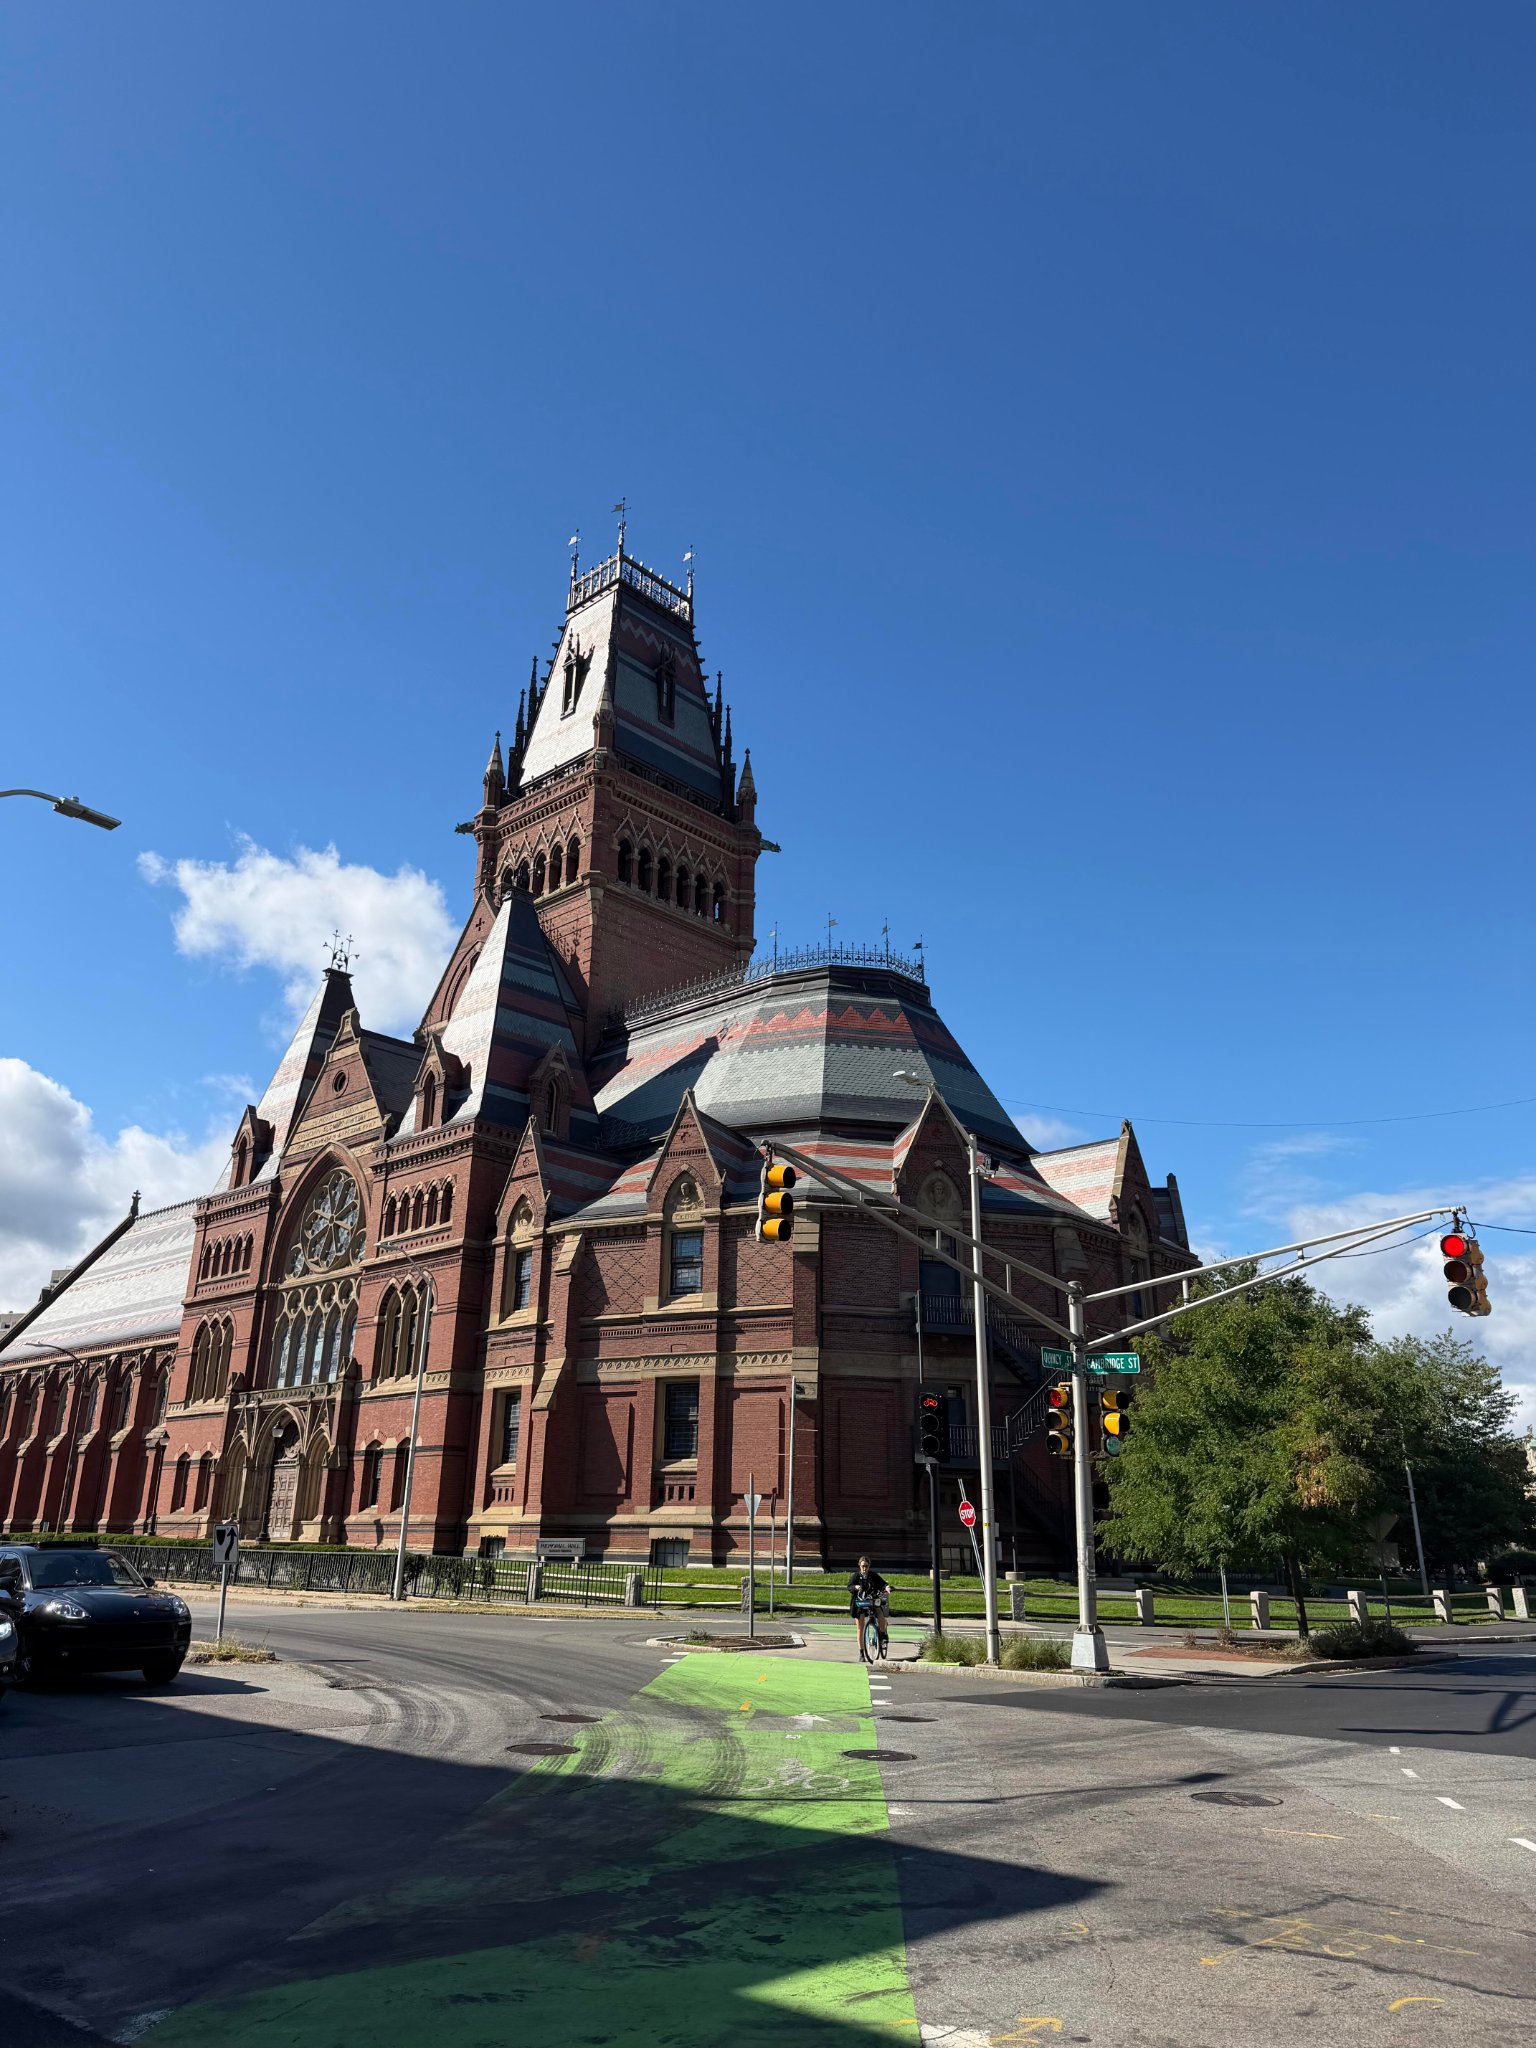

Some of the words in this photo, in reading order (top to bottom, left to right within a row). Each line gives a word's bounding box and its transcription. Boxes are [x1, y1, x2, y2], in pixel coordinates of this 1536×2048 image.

[1086, 1358, 1125, 1369] CAMBRIDGE
[1128, 1357, 1138, 1369] ST
[961, 1509, 974, 1519] STOP
